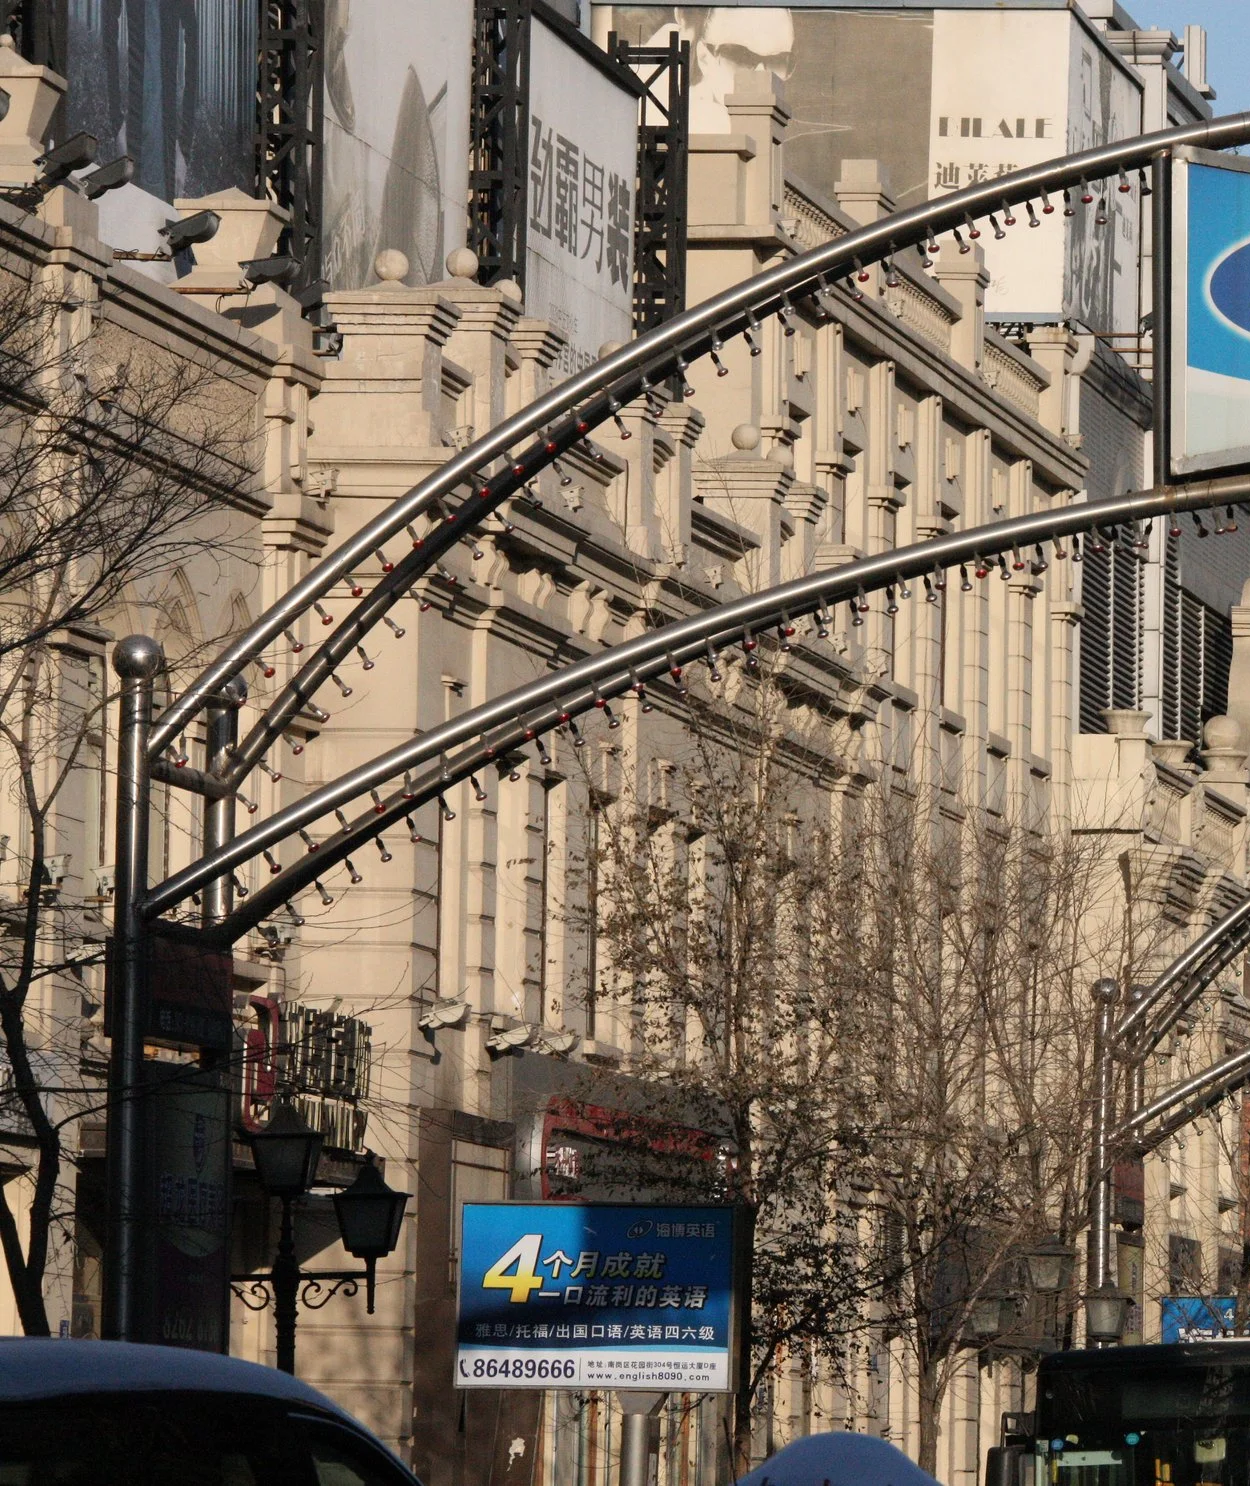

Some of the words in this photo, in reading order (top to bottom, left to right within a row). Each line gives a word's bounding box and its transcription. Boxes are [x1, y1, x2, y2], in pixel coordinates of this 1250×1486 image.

[529, 114, 631, 293] 劲霸男装
[656, 1222, 717, 1239] 海博英语
[482, 1233, 544, 1304] 4
[542, 1250, 666, 1280] 个月成就
[537, 1284, 709, 1309] 一口流利的英语
[475, 1323, 715, 1341] 雅思/托福/出国口语/英语四六级
[473, 1358, 575, 1379] 86489666
[587, 1371, 710, 1382] www.english8090.com
